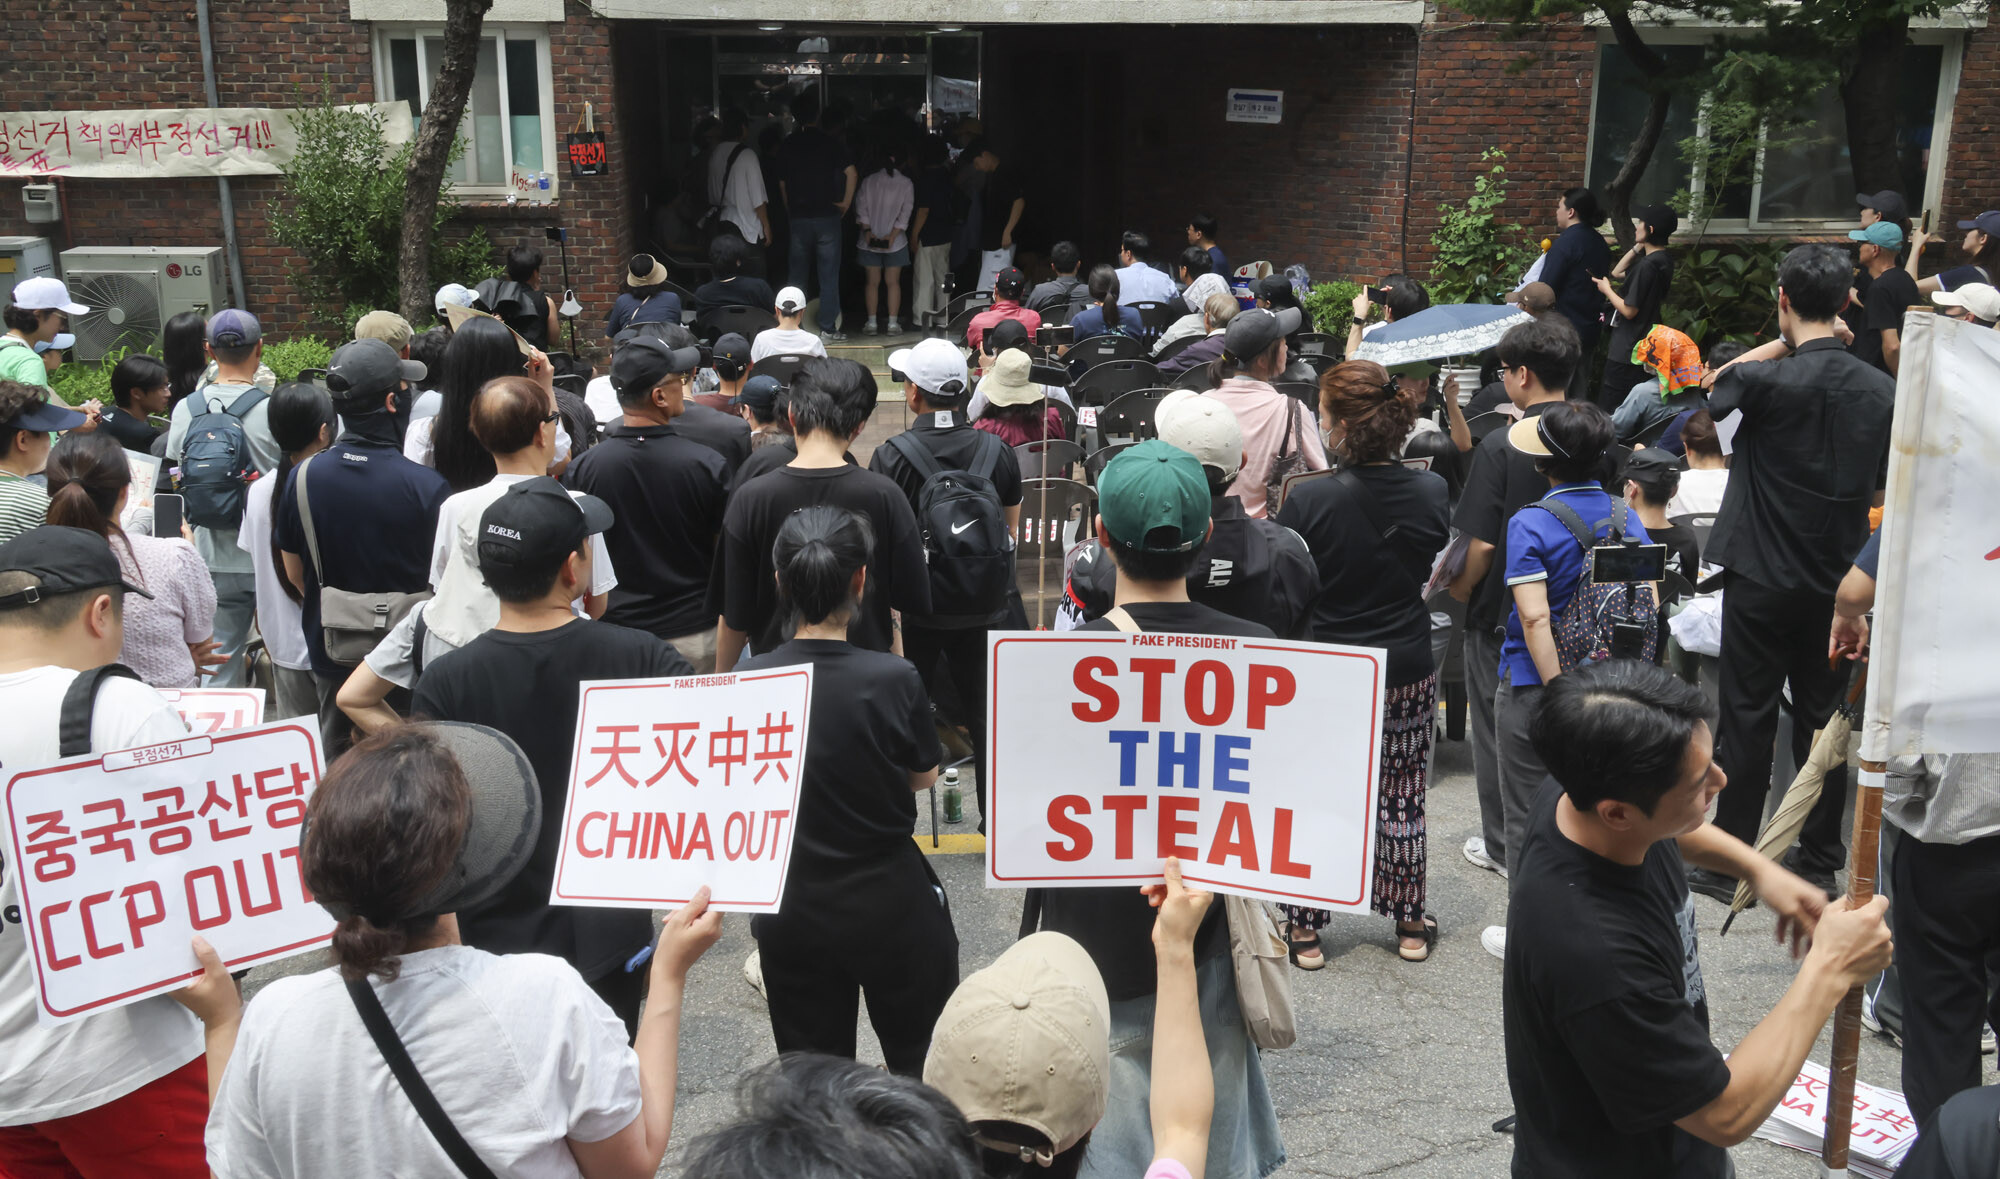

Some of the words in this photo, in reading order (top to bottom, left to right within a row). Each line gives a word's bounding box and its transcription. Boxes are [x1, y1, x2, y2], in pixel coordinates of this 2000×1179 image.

[569, 142, 606, 166] 부정선거
[184, 265, 202, 276] LG
[487, 524, 522, 541] KOREA
[1132, 634, 1166, 648] FAKE
[1167, 635, 1238, 650] PRESIDENT
[674, 678, 694, 689] FAKE
[695, 674, 737, 688] PRESIDENT
[1071, 655, 1297, 730] STOP
[132, 743, 183, 764] 부정선거
[585, 711, 794, 788] 天灭中共
[1109, 730, 1251, 794] THE
[25, 762, 310, 883] 중국공산당
[576, 811, 715, 861] CHINA
[724, 809, 790, 862] OUT
[1045, 794, 1311, 880] STEAL
[39, 880, 166, 971] CCP
